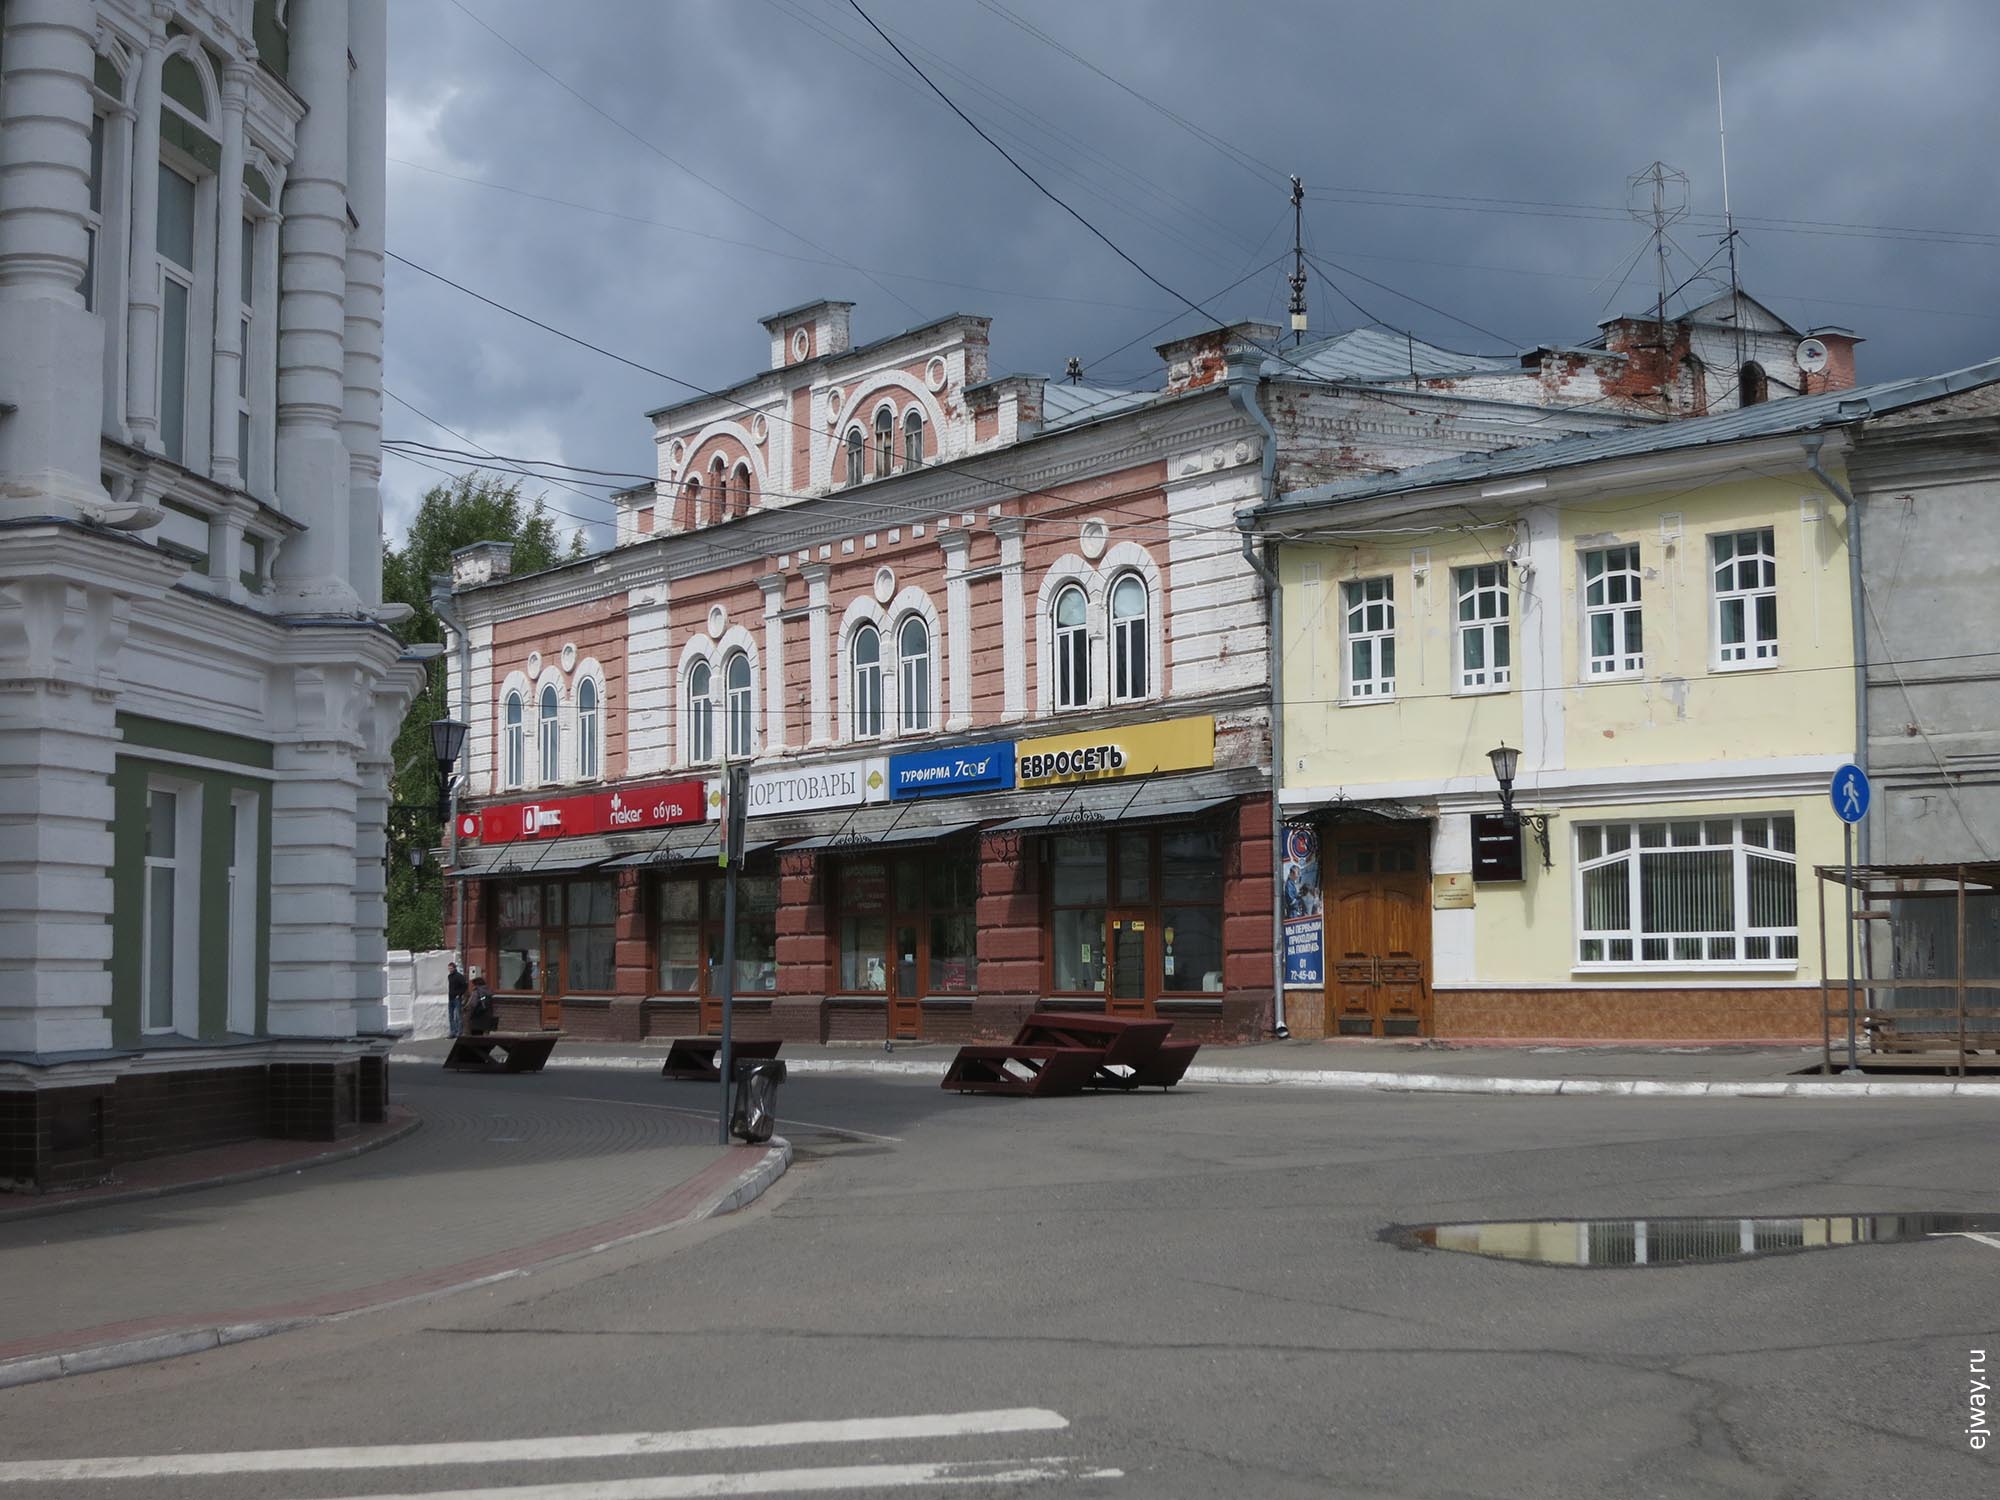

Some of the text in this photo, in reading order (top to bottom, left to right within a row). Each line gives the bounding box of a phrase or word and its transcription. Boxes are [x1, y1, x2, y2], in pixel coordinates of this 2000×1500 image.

[1020, 745, 1125, 779] ЕВРОСЕТЬ
[900, 766, 950, 783] ТУРФИРМА
[610, 805, 643, 825] rieker
[653, 800, 683, 822] обувь
